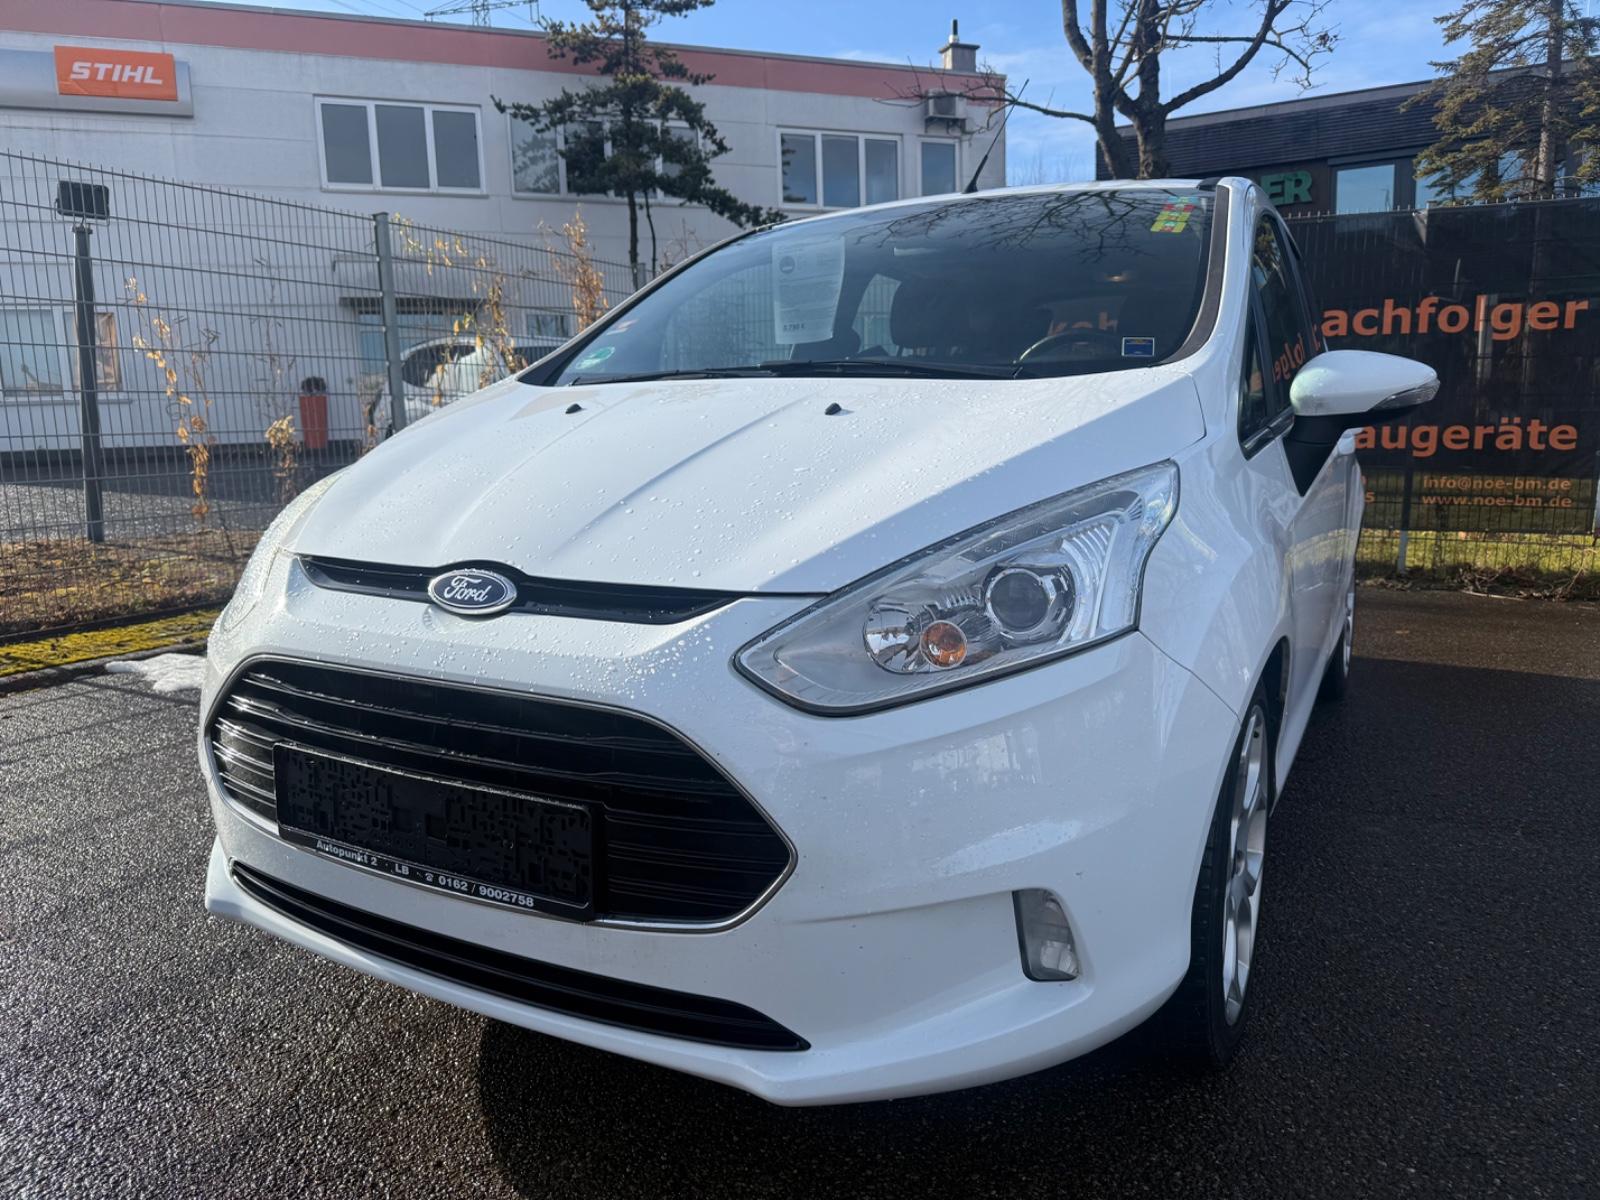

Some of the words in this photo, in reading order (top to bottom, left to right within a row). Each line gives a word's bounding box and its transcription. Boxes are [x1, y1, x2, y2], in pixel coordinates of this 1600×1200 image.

[69, 61, 163, 85] STIHL
[1260, 170, 1313, 206] ER
[1321, 294, 1588, 341] achfolger
[1354, 416, 1578, 458] augeräte
[1423, 475, 1572, 491] info@noe-bm.de
[1422, 493, 1572, 508] www.noe-bm.de
[443, 575, 493, 602] Ford
[316, 839, 368, 865] Autopunkt
[370, 856, 378, 867] 2
[394, 863, 410, 876] LB
[438, 875, 469, 892] 0162
[478, 885, 535, 908] 9002758
